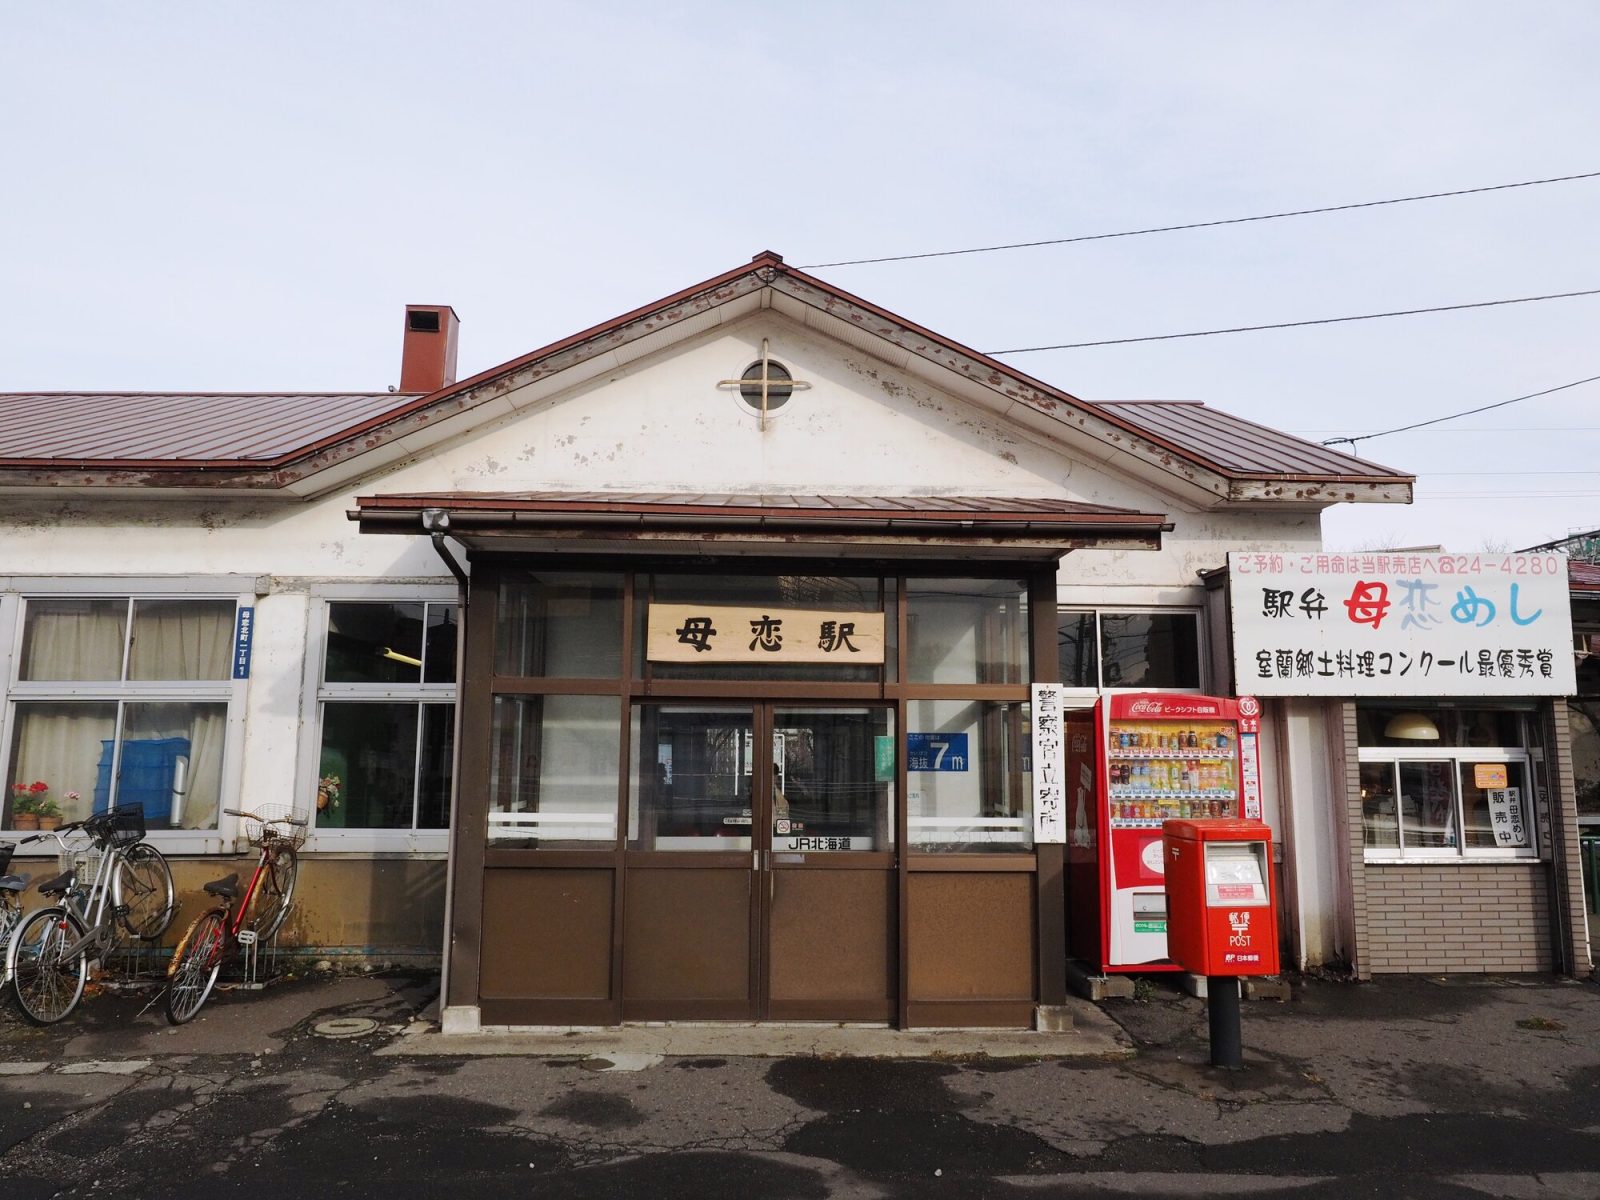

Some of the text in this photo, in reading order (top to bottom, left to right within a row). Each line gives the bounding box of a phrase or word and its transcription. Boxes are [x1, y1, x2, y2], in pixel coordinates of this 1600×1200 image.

[1238, 556, 1438, 574] ご予約・ご用命は当駅売店へ
[1262, 579, 1542, 631] 駅弁 母恋めし
[675, 615, 861, 653] 母恋駅
[1255, 649, 1555, 680] 室蘭郷土料理コンクール最優秀賞
[909, 742, 963, 770] 海抜 7 m
[1492, 791, 1512, 843] 販売中
[788, 838, 851, 850] JR北海道
[1228, 911, 1250, 924] 郵便
[1229, 935, 1251, 947] POST
